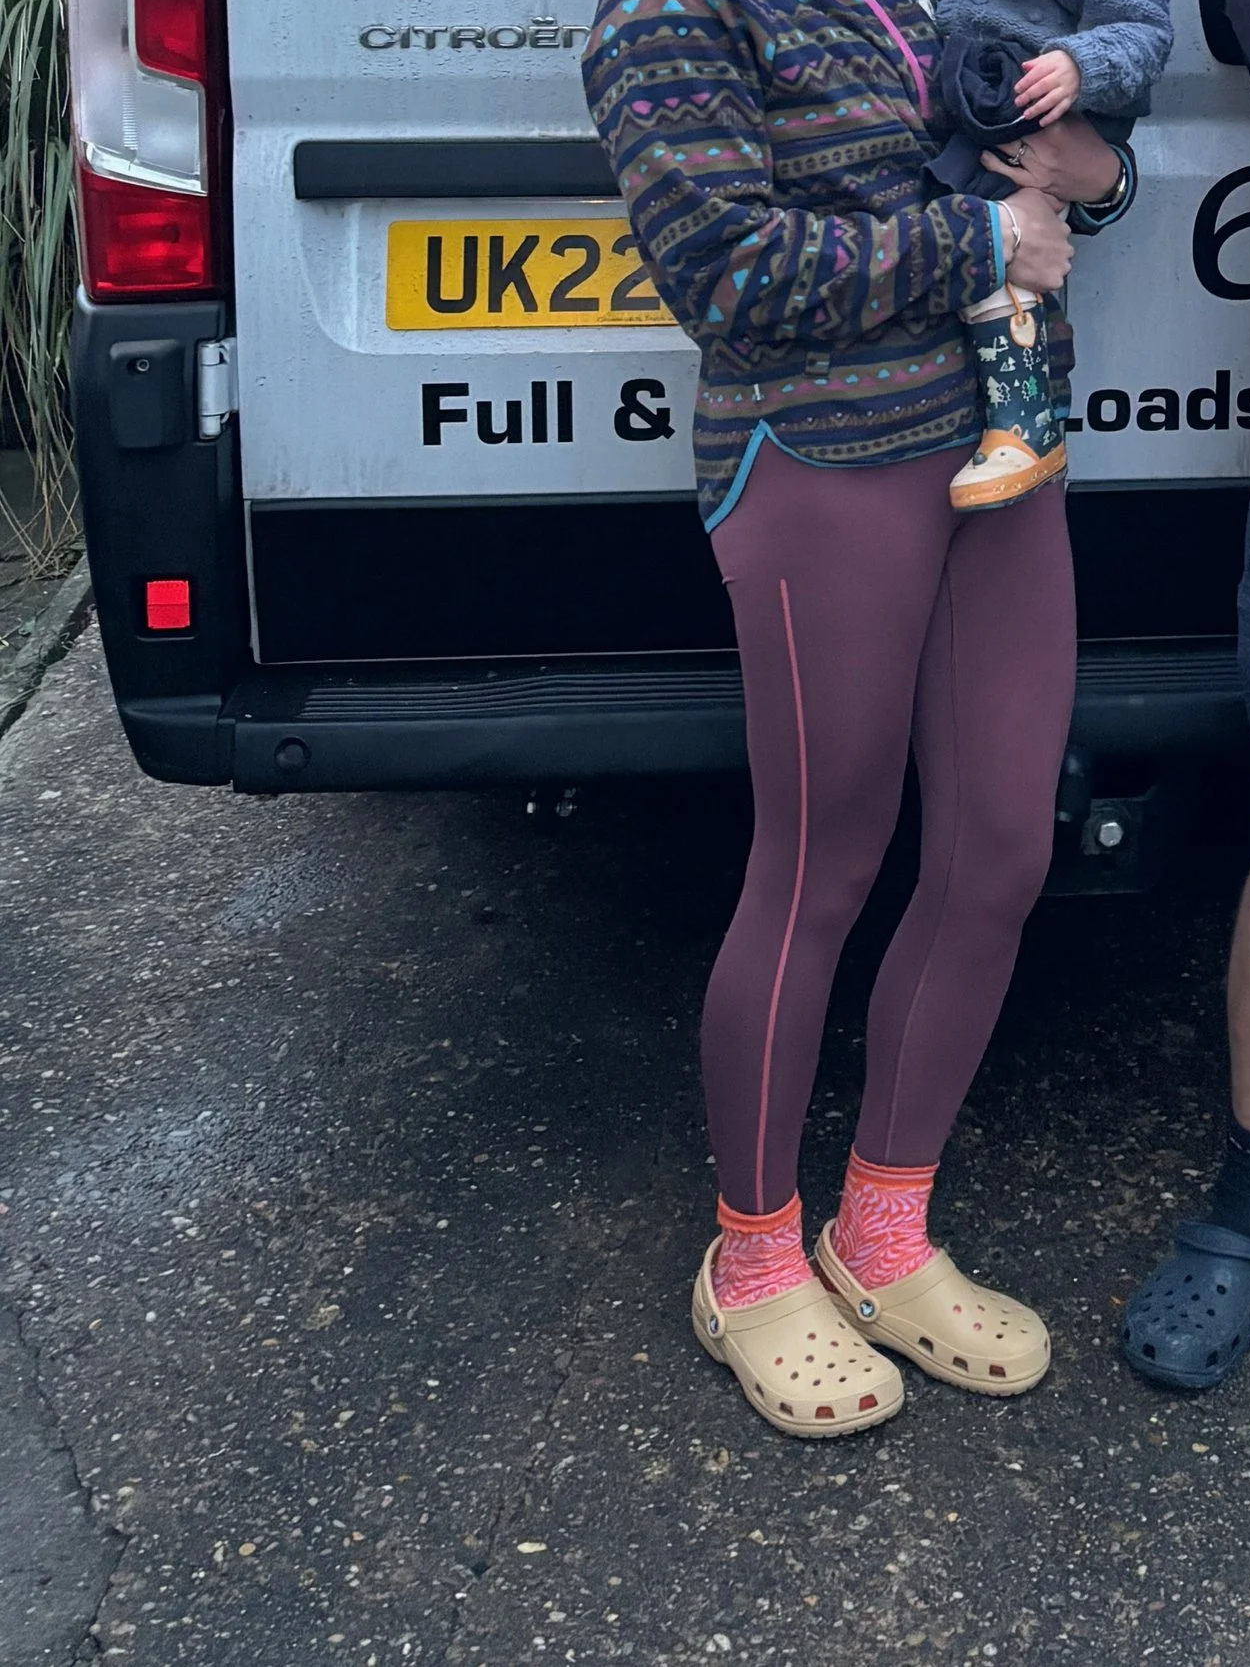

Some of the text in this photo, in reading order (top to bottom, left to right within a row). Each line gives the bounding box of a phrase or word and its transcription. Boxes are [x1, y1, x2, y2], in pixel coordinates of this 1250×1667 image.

[425, 234, 661, 313] UK22
[421, 380, 574, 446] Full
[613, 377, 675, 442] &
